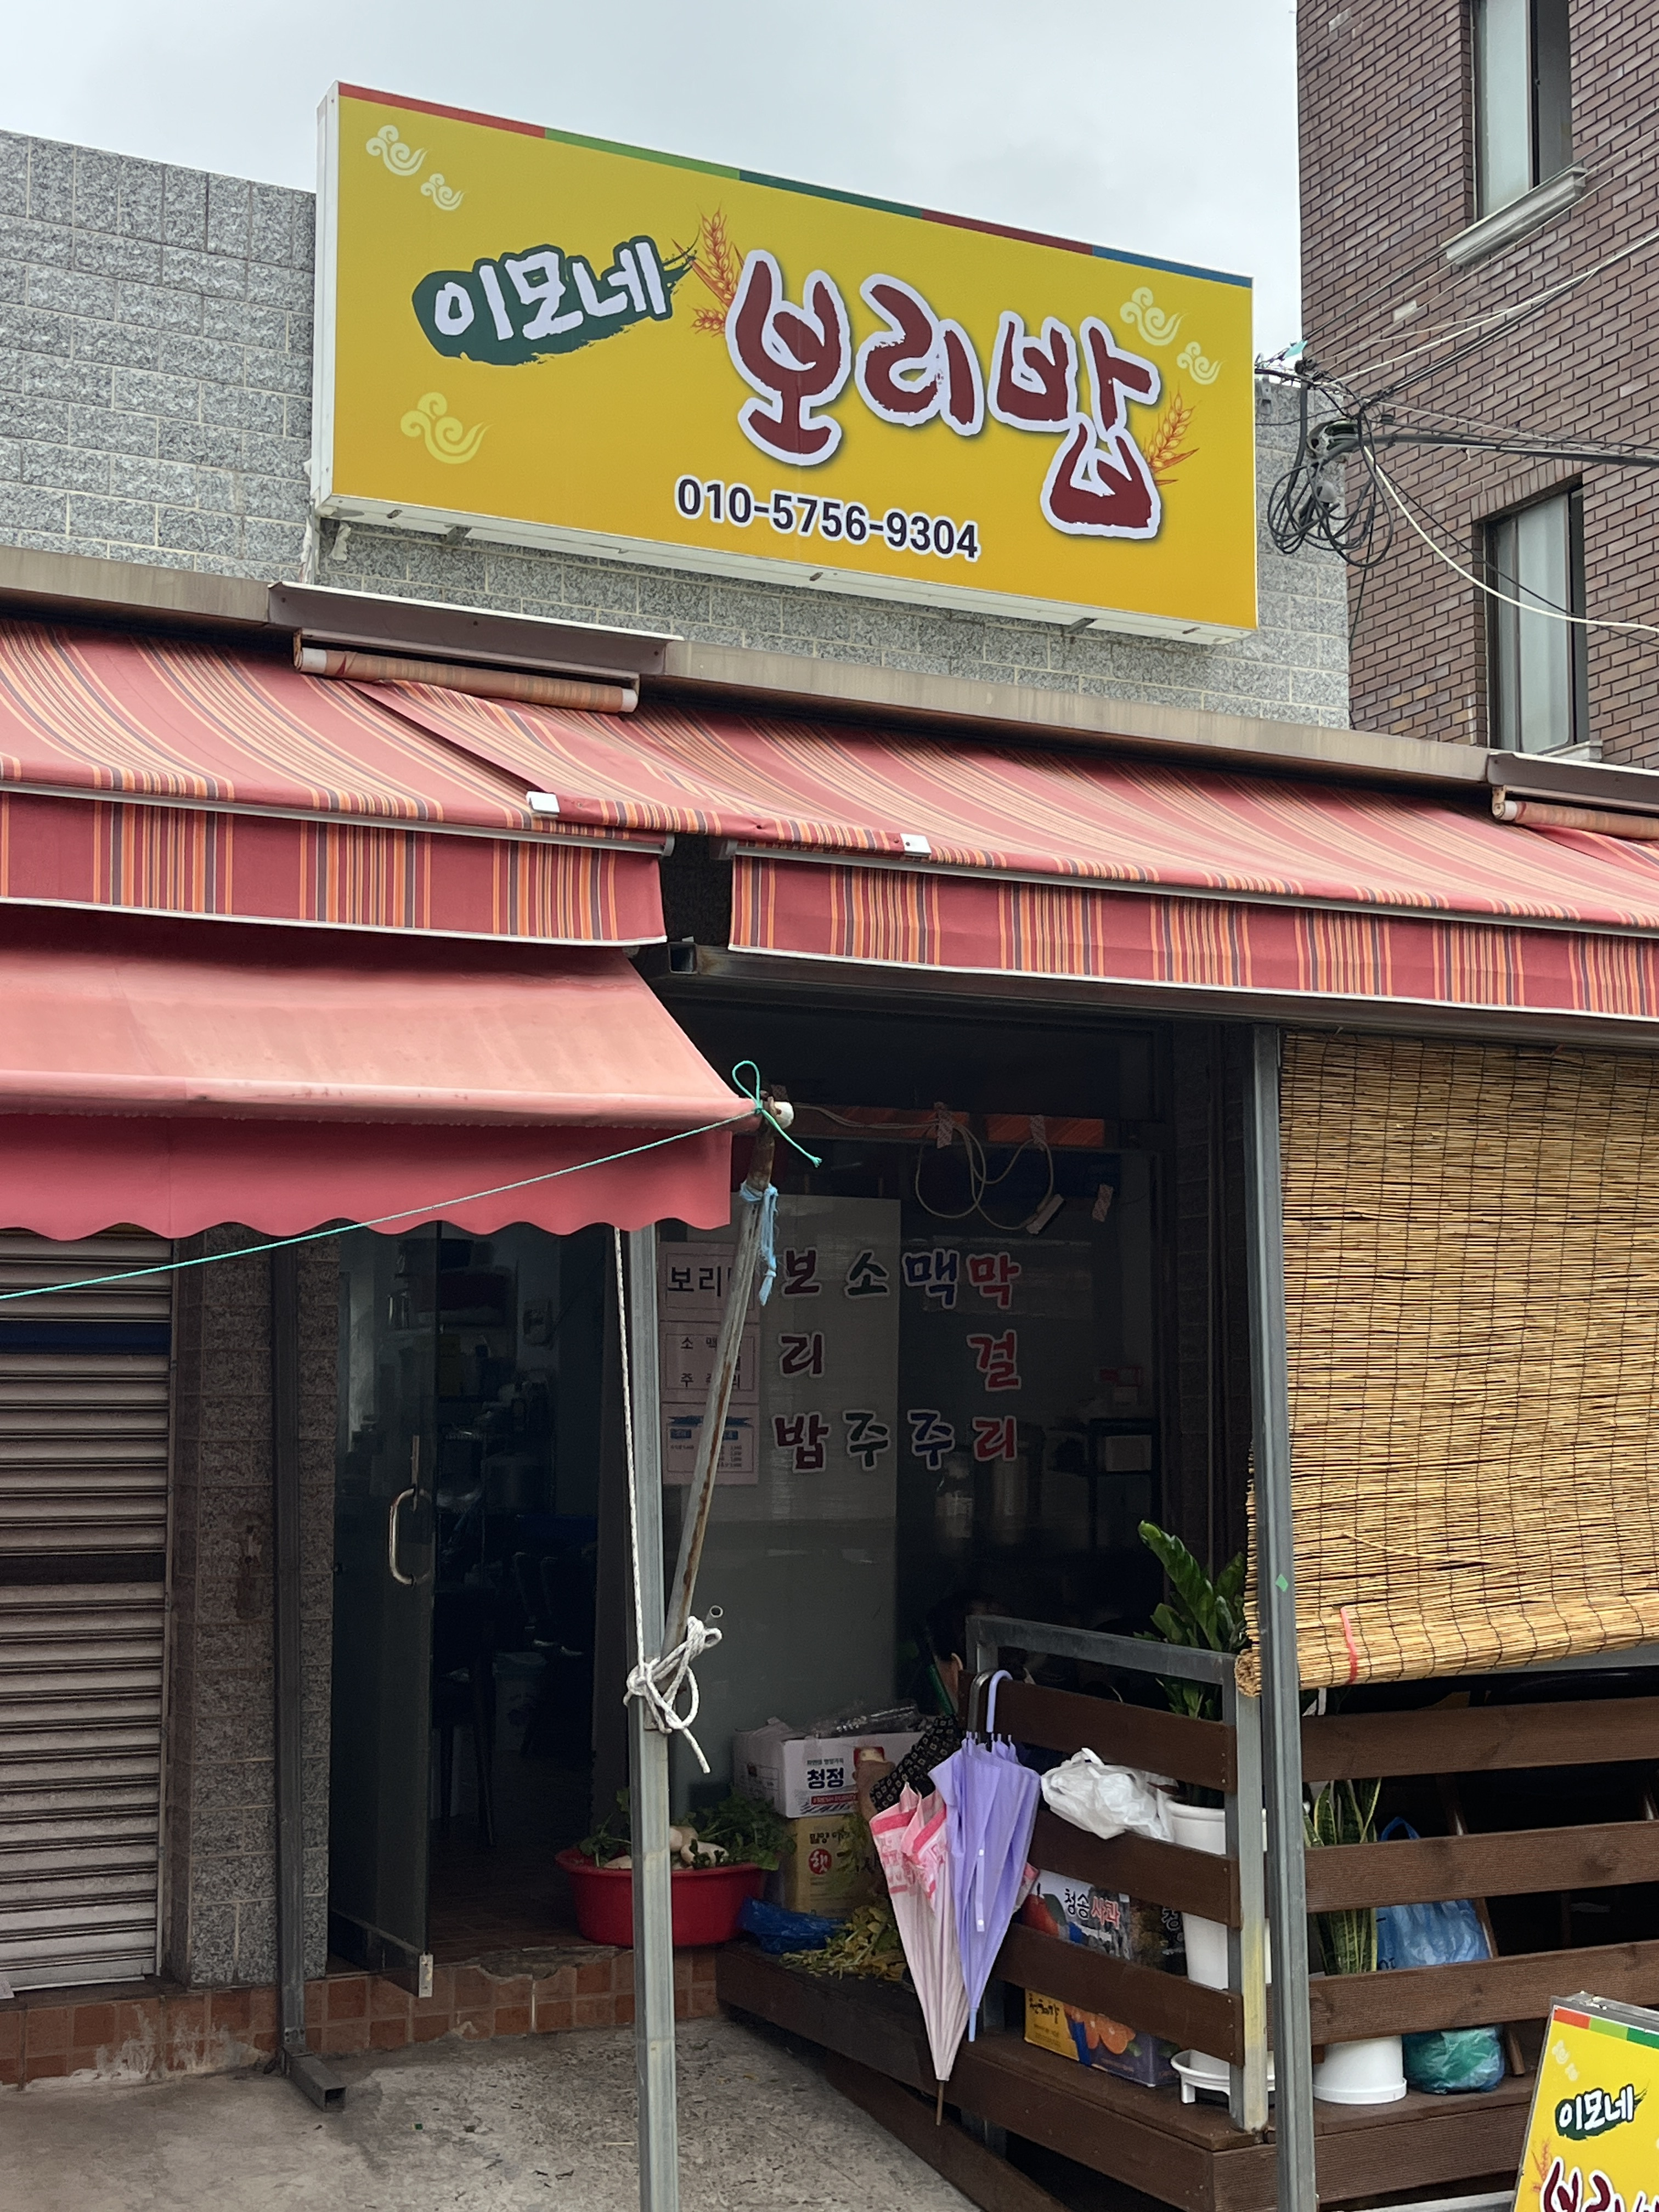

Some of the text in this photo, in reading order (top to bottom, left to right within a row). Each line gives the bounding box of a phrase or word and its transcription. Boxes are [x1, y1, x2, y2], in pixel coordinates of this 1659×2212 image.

[434, 241, 1161, 540] 이모네 보리밥
[676, 477, 979, 561] 010-5756-9304
[668, 1266, 732, 1296] 보리
[773, 1248, 829, 1472] 보리밥
[844, 1249, 890, 1471] 소주
[904, 1248, 960, 1470] 맥주
[966, 1251, 1022, 1462] 막걸리
[807, 1767, 844, 1790] 청정
[1064, 1888, 1120, 1931] 청송 사과
[1559, 2085, 1634, 2131] 이모네
